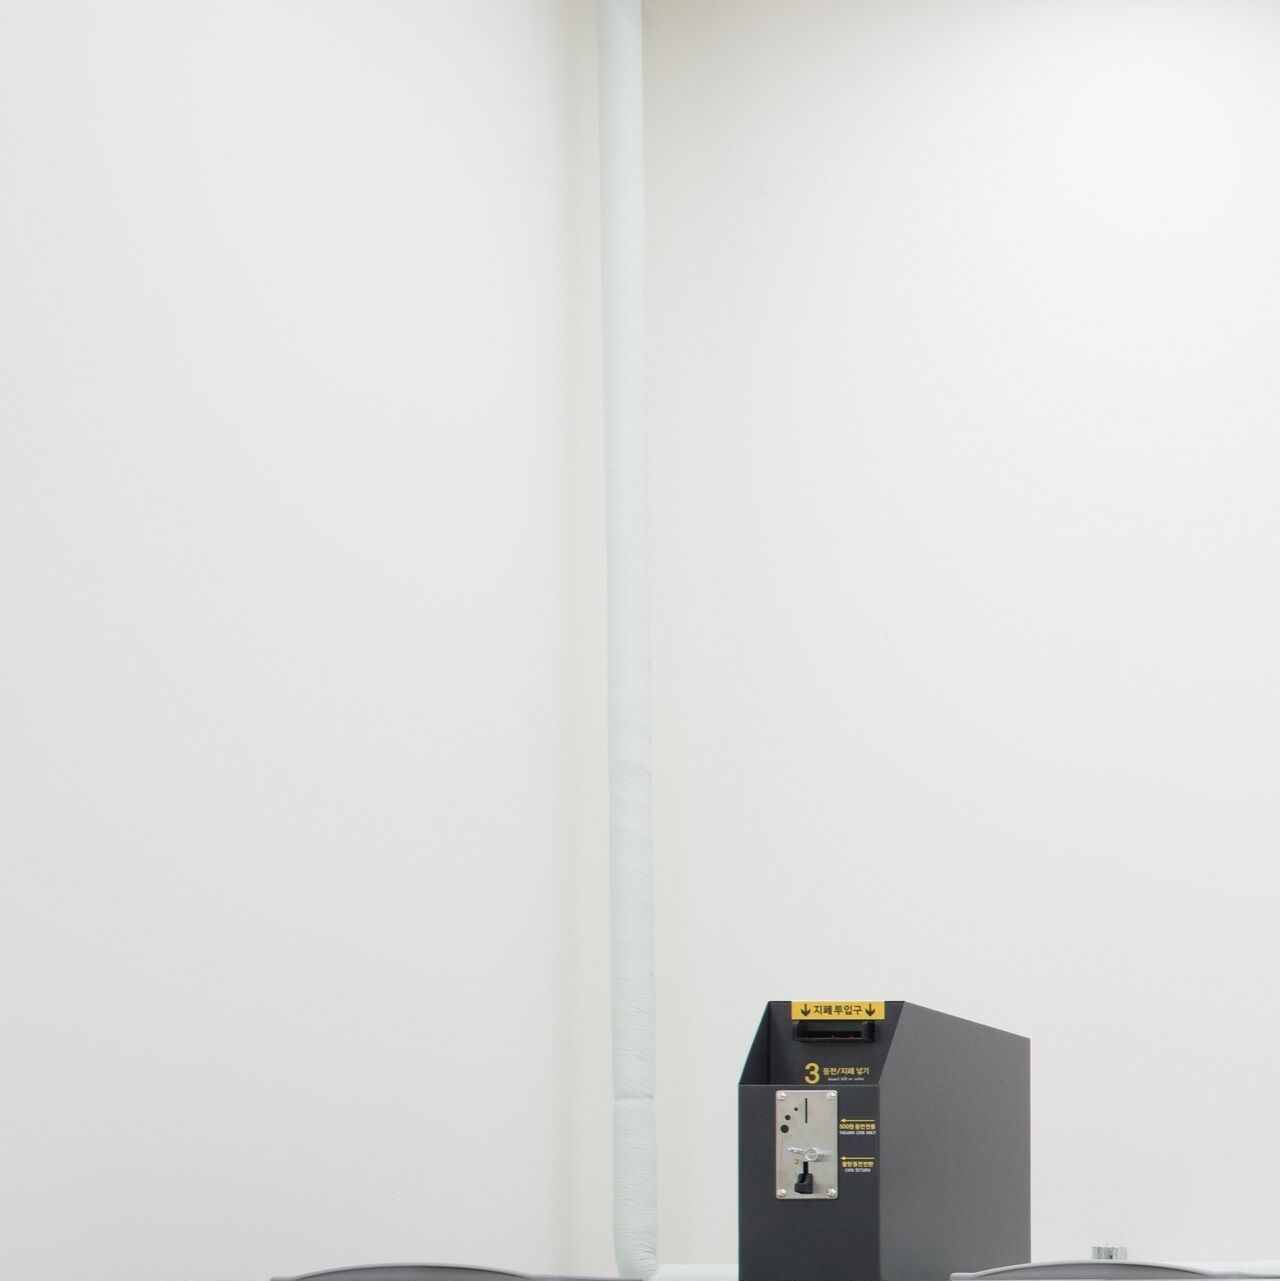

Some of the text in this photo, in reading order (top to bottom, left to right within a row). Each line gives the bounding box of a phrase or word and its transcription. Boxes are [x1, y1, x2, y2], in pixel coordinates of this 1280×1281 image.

[813, 1004, 862, 1016] 지폐 투입구
[804, 1062, 820, 1084] 3
